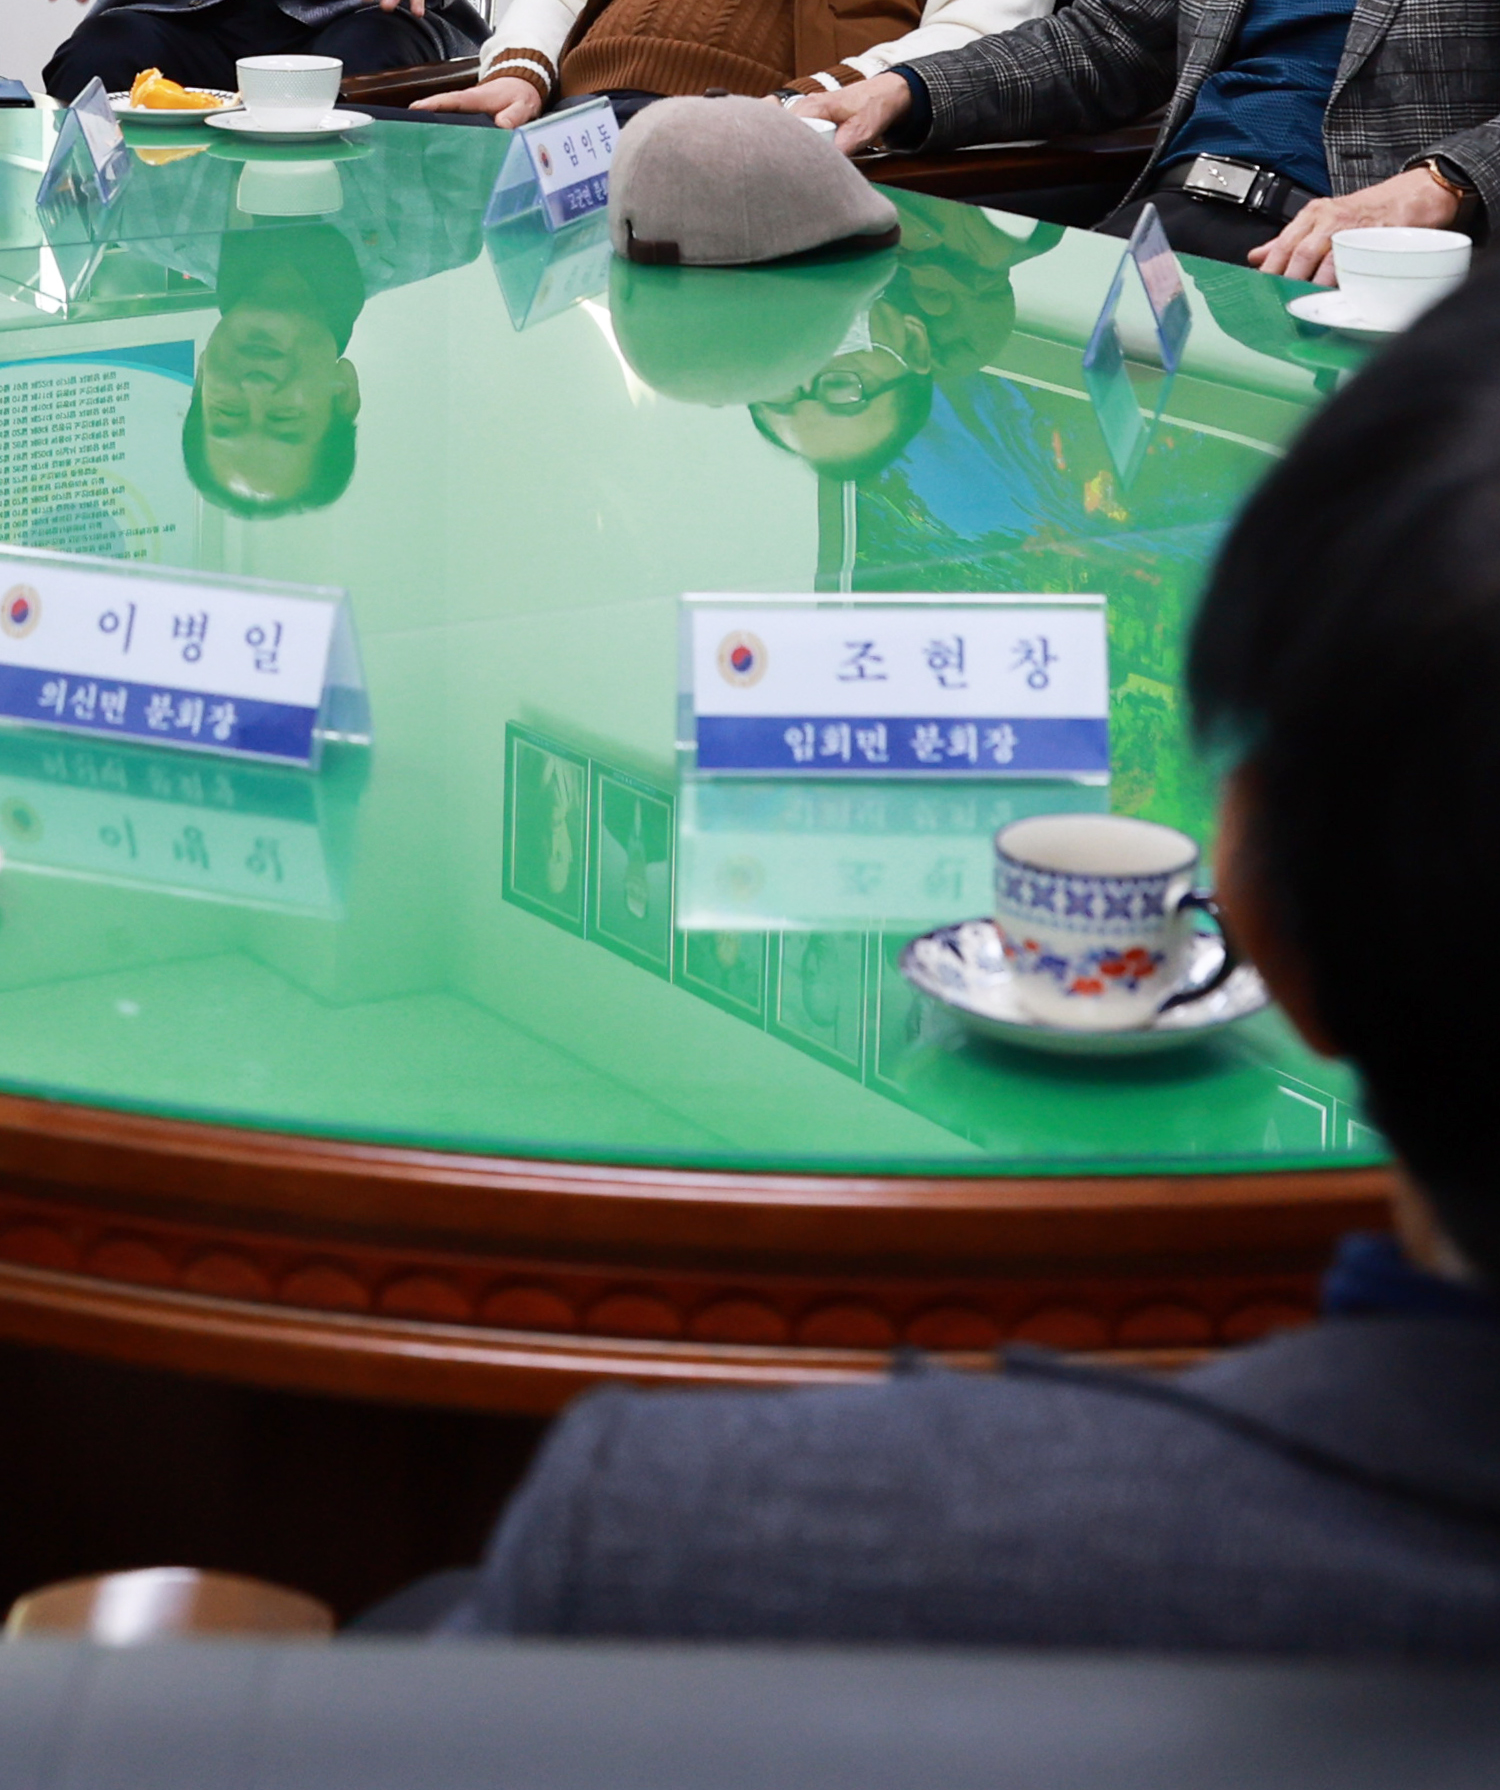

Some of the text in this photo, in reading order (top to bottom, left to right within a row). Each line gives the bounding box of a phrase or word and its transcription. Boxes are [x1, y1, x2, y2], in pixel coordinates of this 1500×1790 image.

[38, 677, 238, 742] 의신면 분회장
[910, 722, 1019, 764] 분회장
